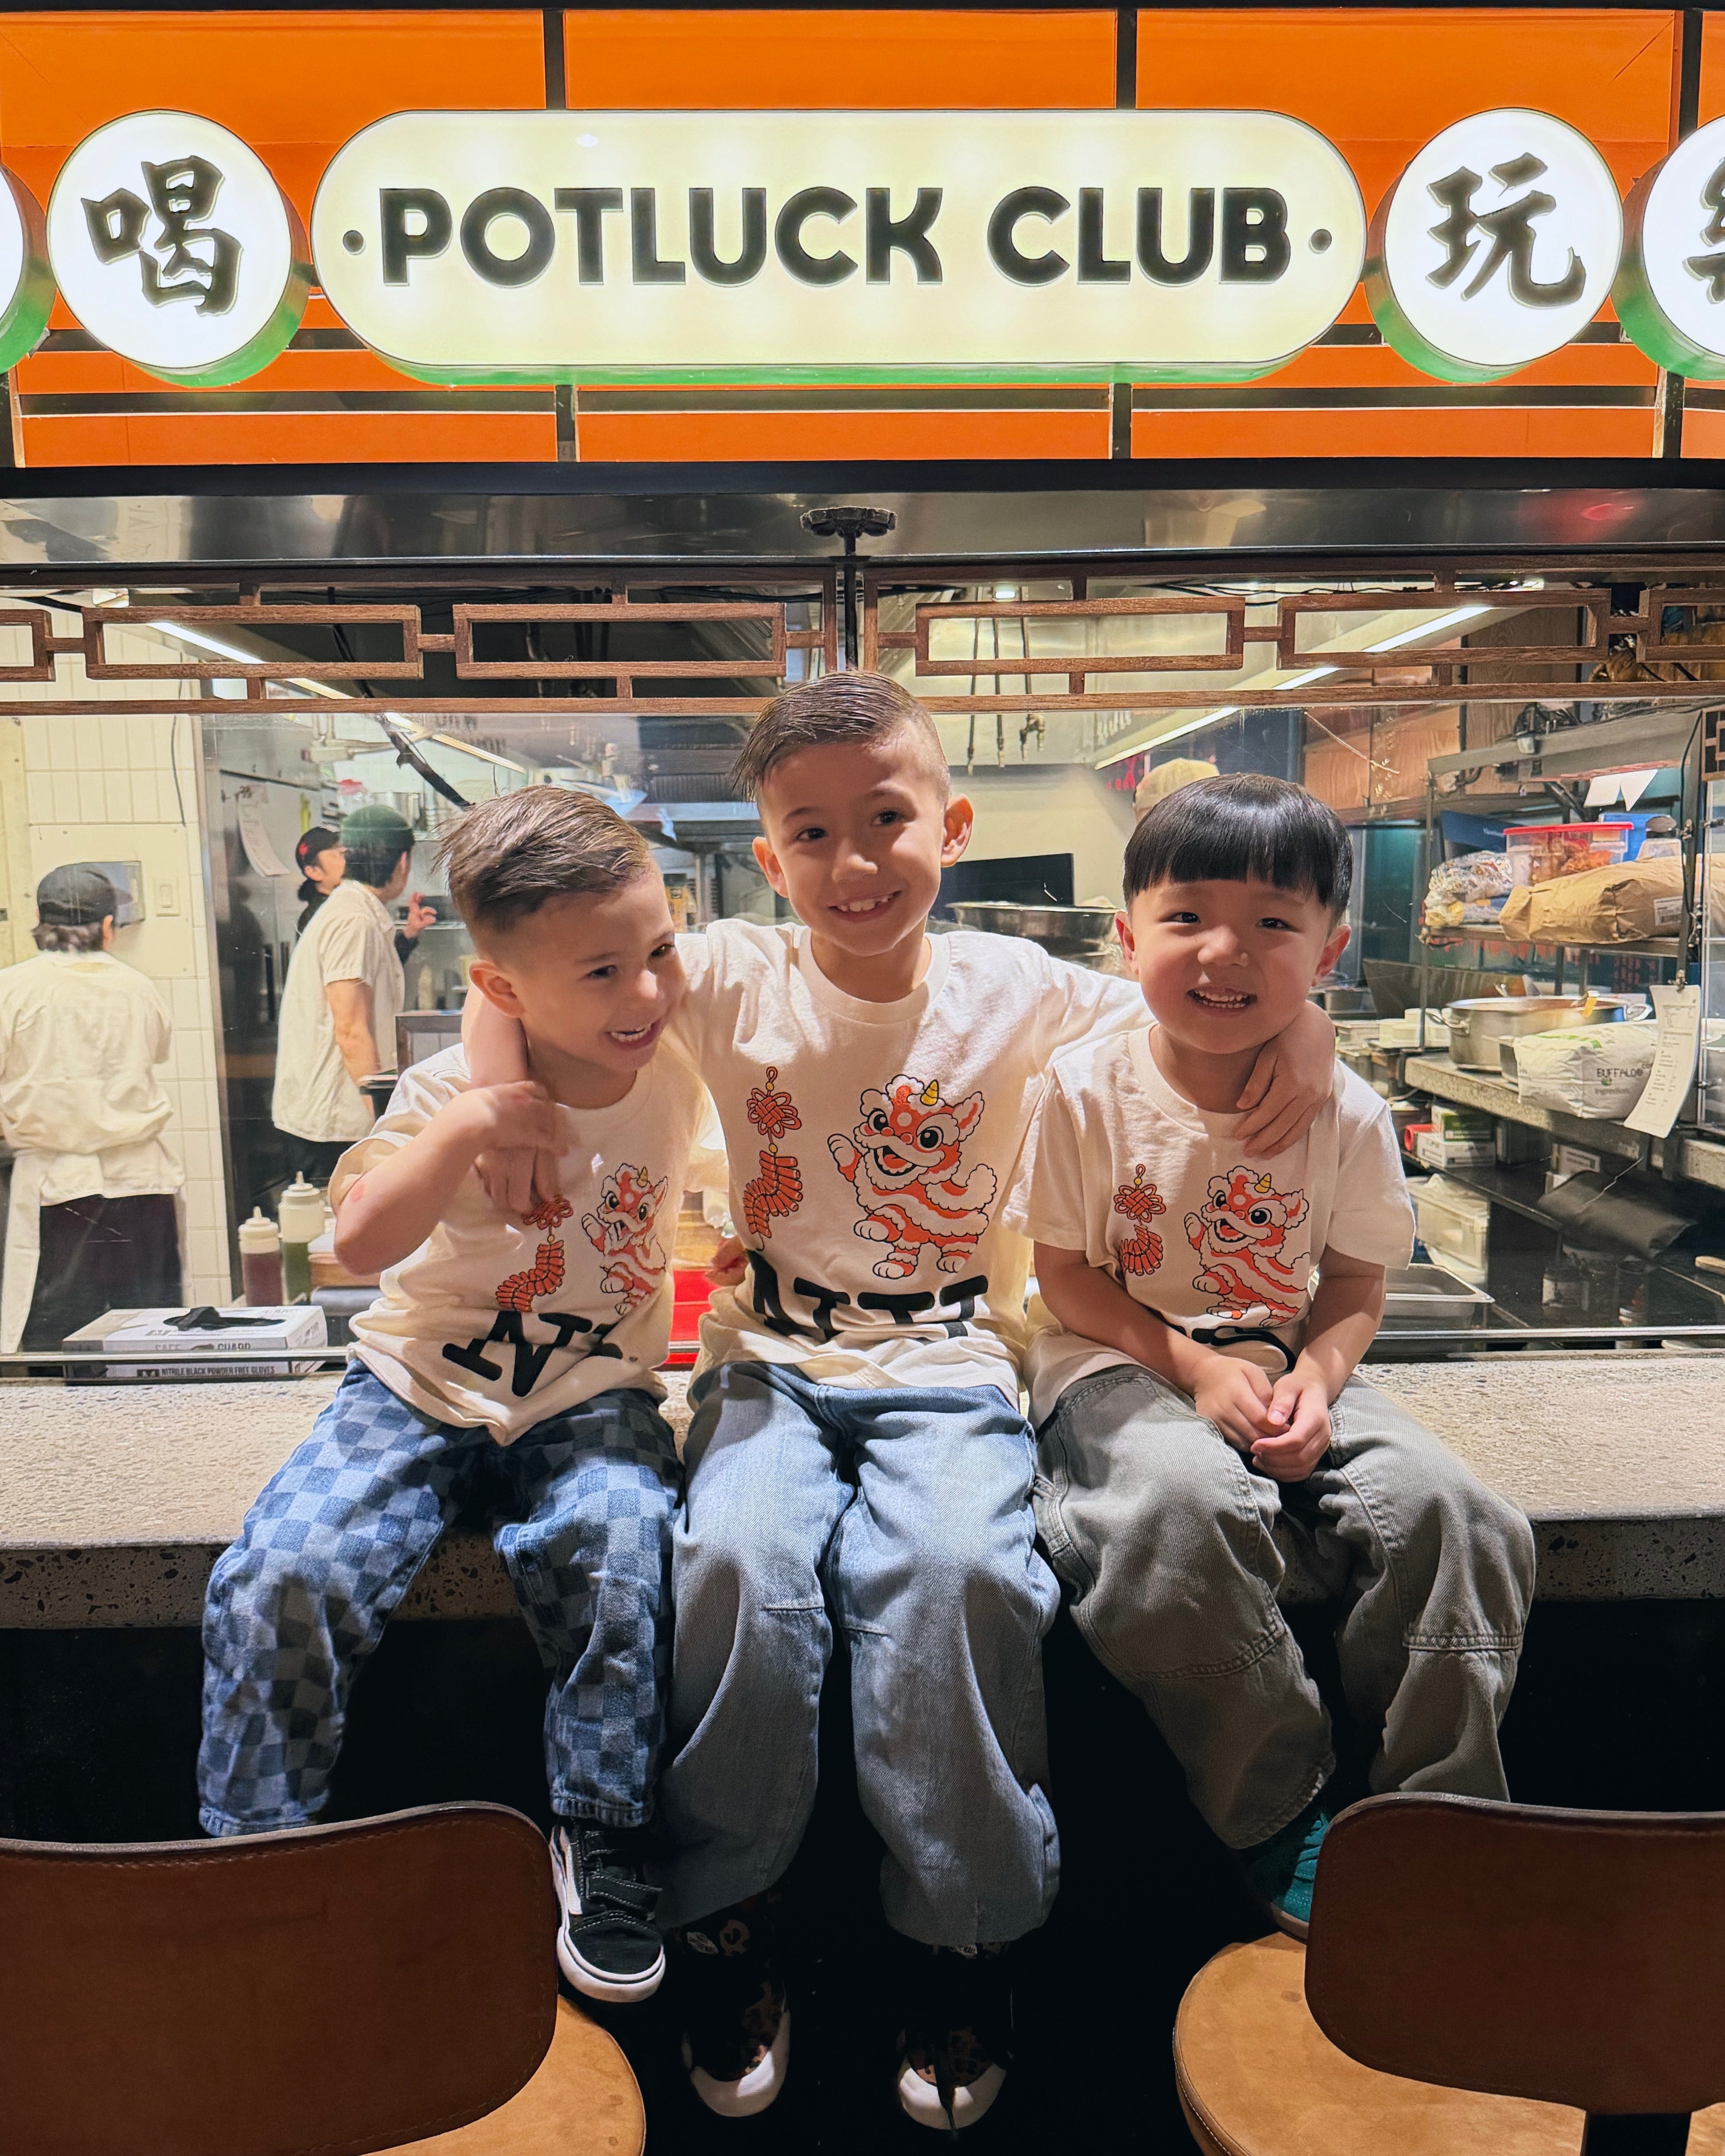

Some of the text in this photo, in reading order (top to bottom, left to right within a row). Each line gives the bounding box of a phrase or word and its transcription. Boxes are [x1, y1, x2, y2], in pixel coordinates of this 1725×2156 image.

[81, 155, 243, 316] 喝
[379, 185, 1292, 288] POTLUCK CLUB
[1426, 152, 1587, 310] 玩
